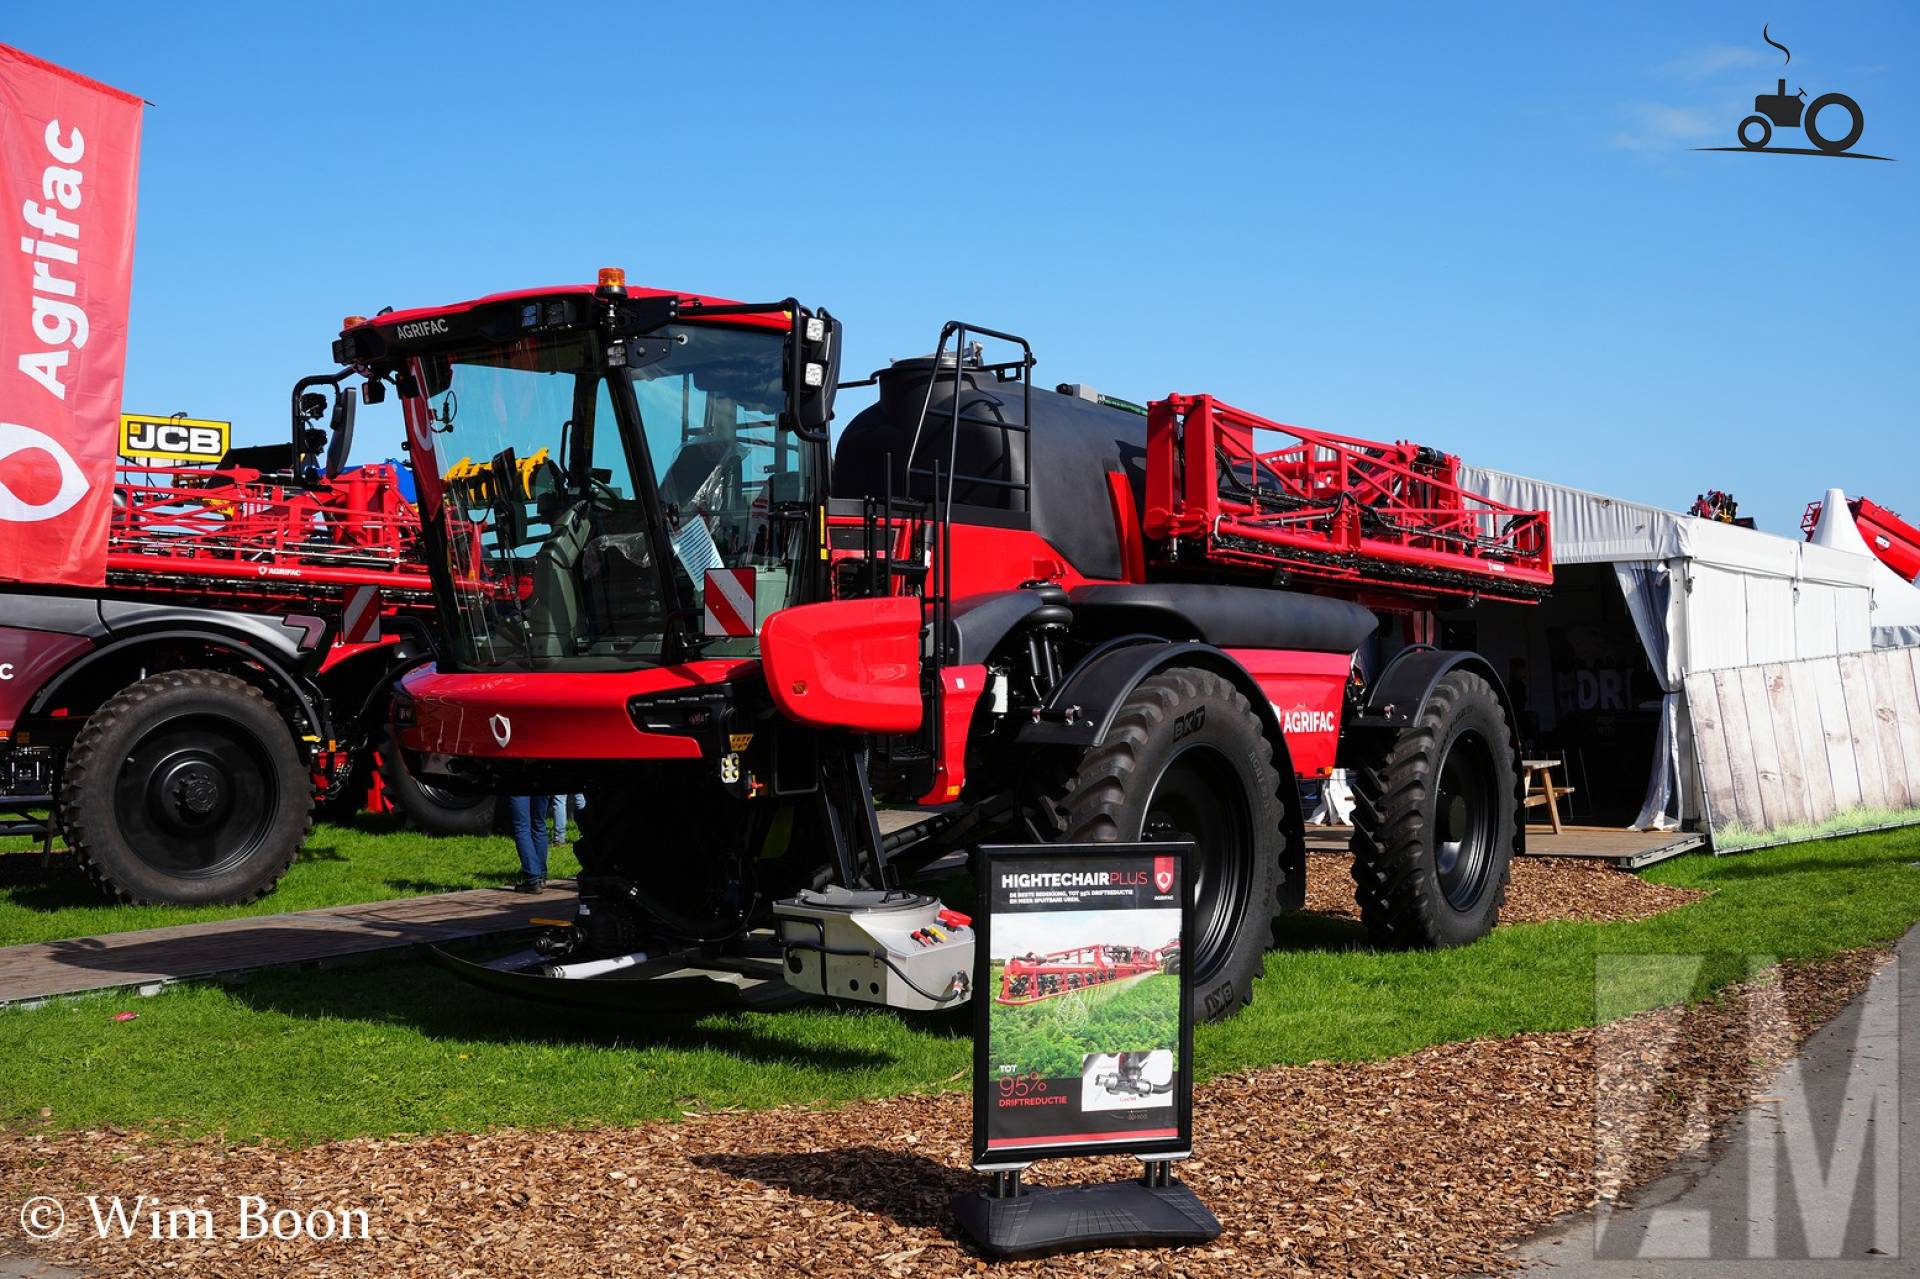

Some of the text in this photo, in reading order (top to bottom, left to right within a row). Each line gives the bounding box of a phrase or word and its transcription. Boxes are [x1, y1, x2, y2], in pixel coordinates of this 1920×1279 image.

[18, 118, 90, 401] Agrifac
[396, 318, 449, 340] AGRIFAC
[128, 423, 222, 454] JCB
[1173, 705, 1206, 743] BKT
[1283, 711, 1335, 733] AGRIFAC
[1000, 1064, 1017, 1073] TOT
[999, 1072, 1047, 1097] 95%
[999, 1095, 1068, 1107] DRIFTREDUCTIE
